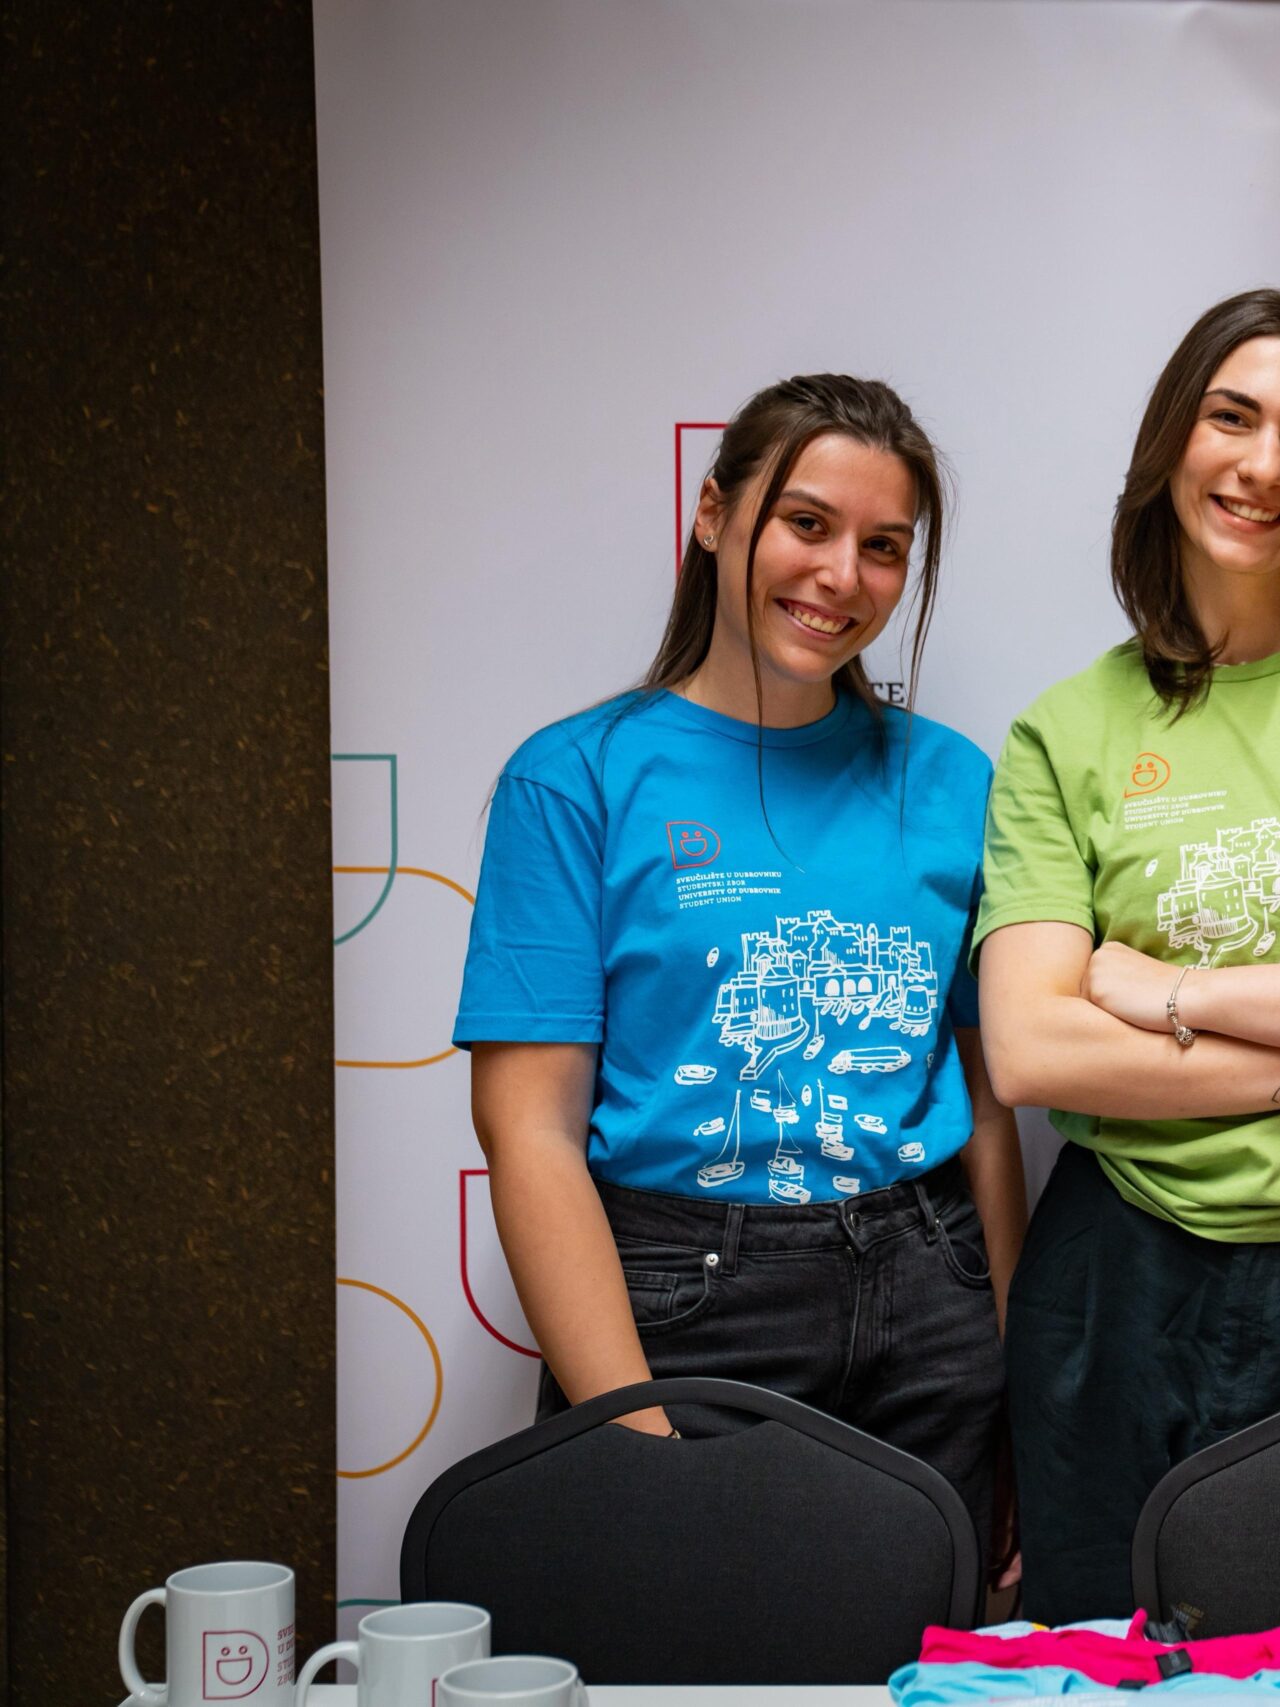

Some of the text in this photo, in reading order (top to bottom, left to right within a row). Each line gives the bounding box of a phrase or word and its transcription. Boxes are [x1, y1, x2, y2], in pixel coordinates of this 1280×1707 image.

[677, 881, 725, 892] STUDENTSKI
[679, 889, 725, 901] UNIVERSITY
[680, 896, 742, 909] STUDENT UNION
